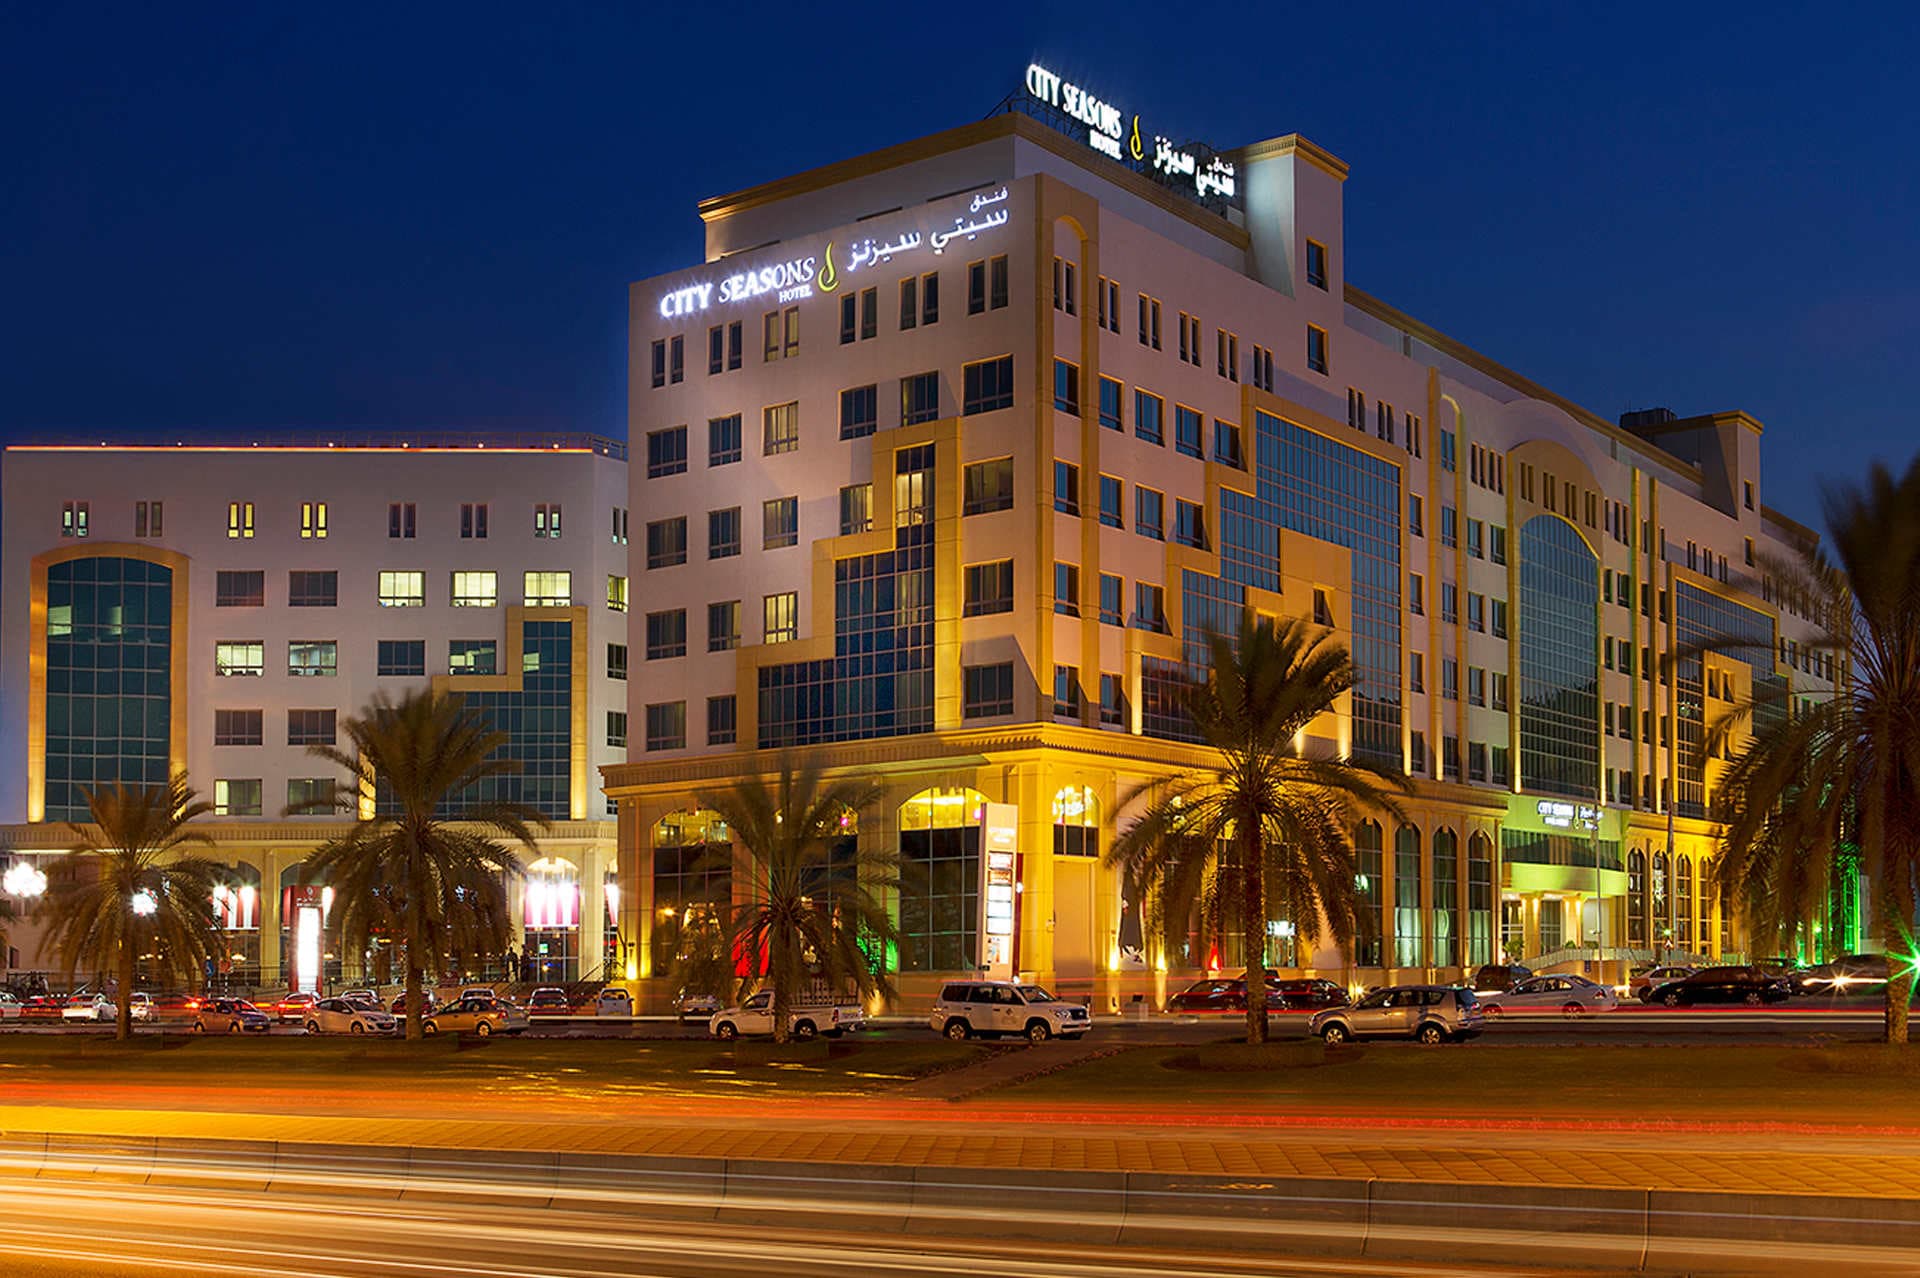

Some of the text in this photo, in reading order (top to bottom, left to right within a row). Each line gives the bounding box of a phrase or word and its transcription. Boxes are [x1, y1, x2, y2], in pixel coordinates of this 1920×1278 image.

[1026, 63, 1122, 139] CITY SEASONS
[1089, 128, 1123, 160] HOTEL
[969, 186, 1009, 212] فندق
[847, 209, 1009, 271] سيتي سيزنز
[659, 256, 816, 318] CITY SEASONS
[778, 284, 813, 304] HOTEL
